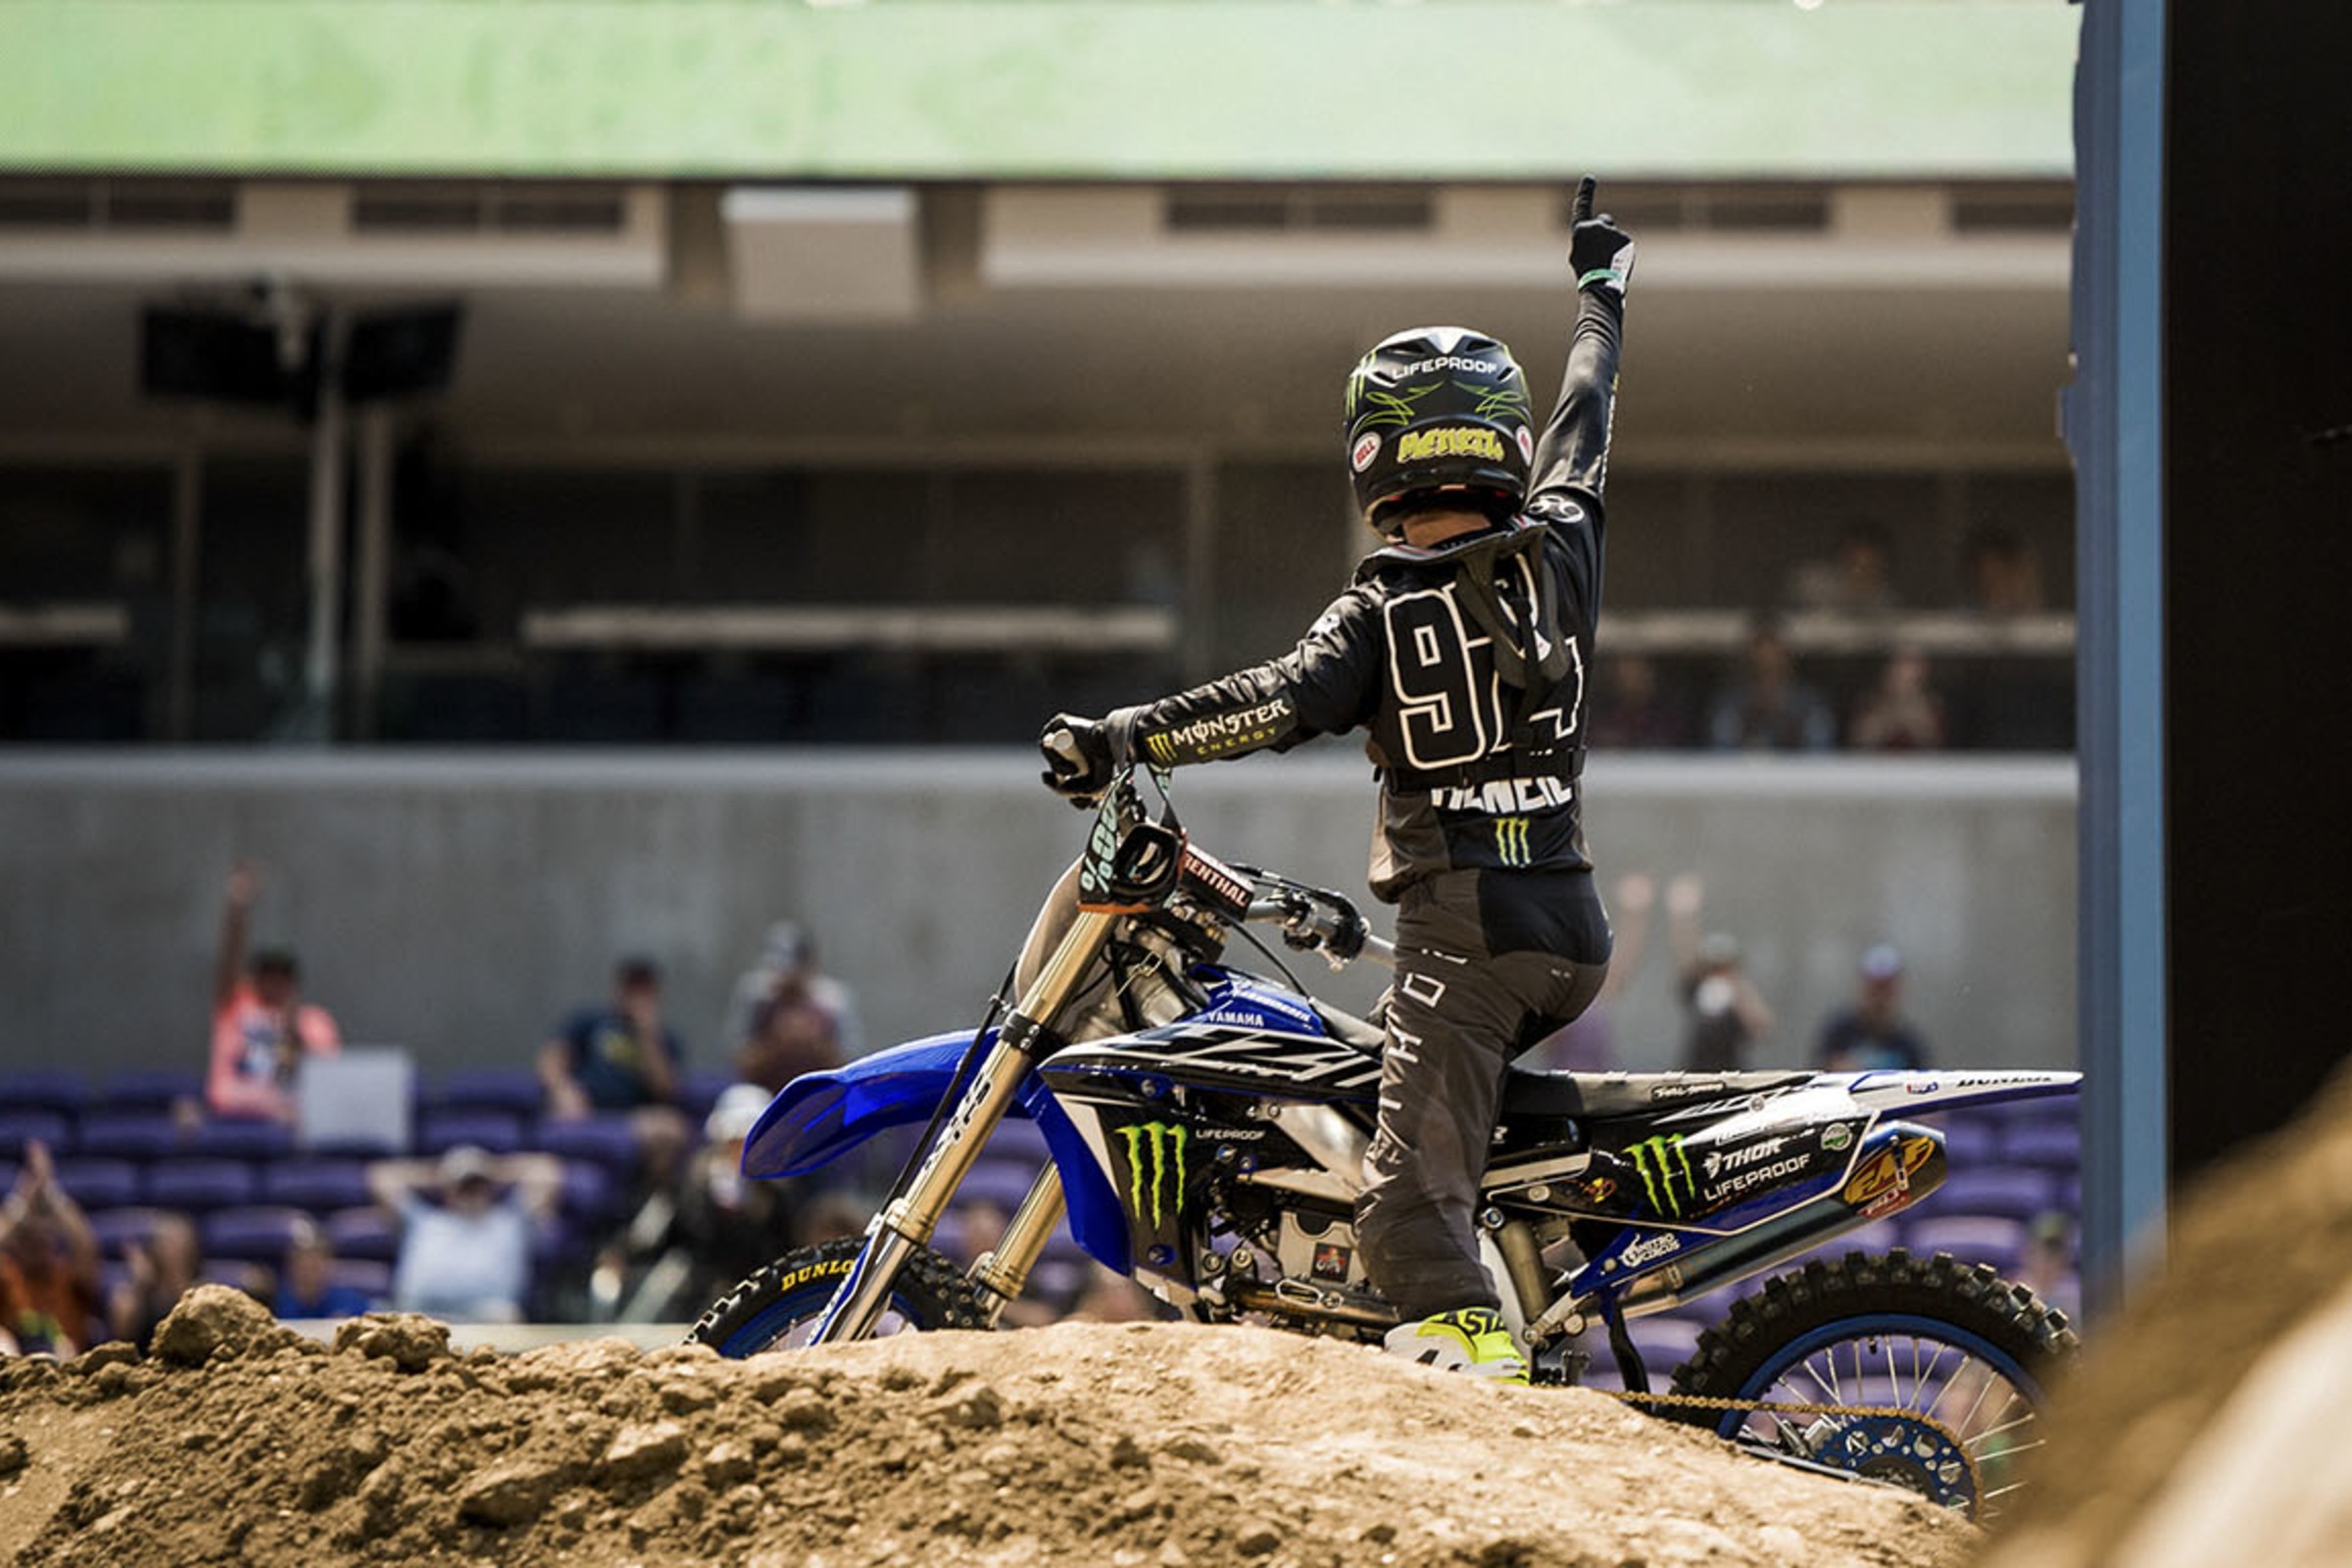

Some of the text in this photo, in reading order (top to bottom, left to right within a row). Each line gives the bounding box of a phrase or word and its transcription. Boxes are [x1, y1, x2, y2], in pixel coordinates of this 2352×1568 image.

[1392, 357, 1497, 379] LIFEPROOF
[1171, 697, 1292, 748] MONSTER
[1196, 727, 1276, 756] ENERGY
[1207, 1010, 1264, 1028] YAMAHA
[1195, 1128, 1266, 1141] LIFEPROOF
[1721, 1137, 1788, 1171] THOR
[1703, 1153, 1811, 1200] LIFEPROOF
[781, 1258, 856, 1292] DUNLO
